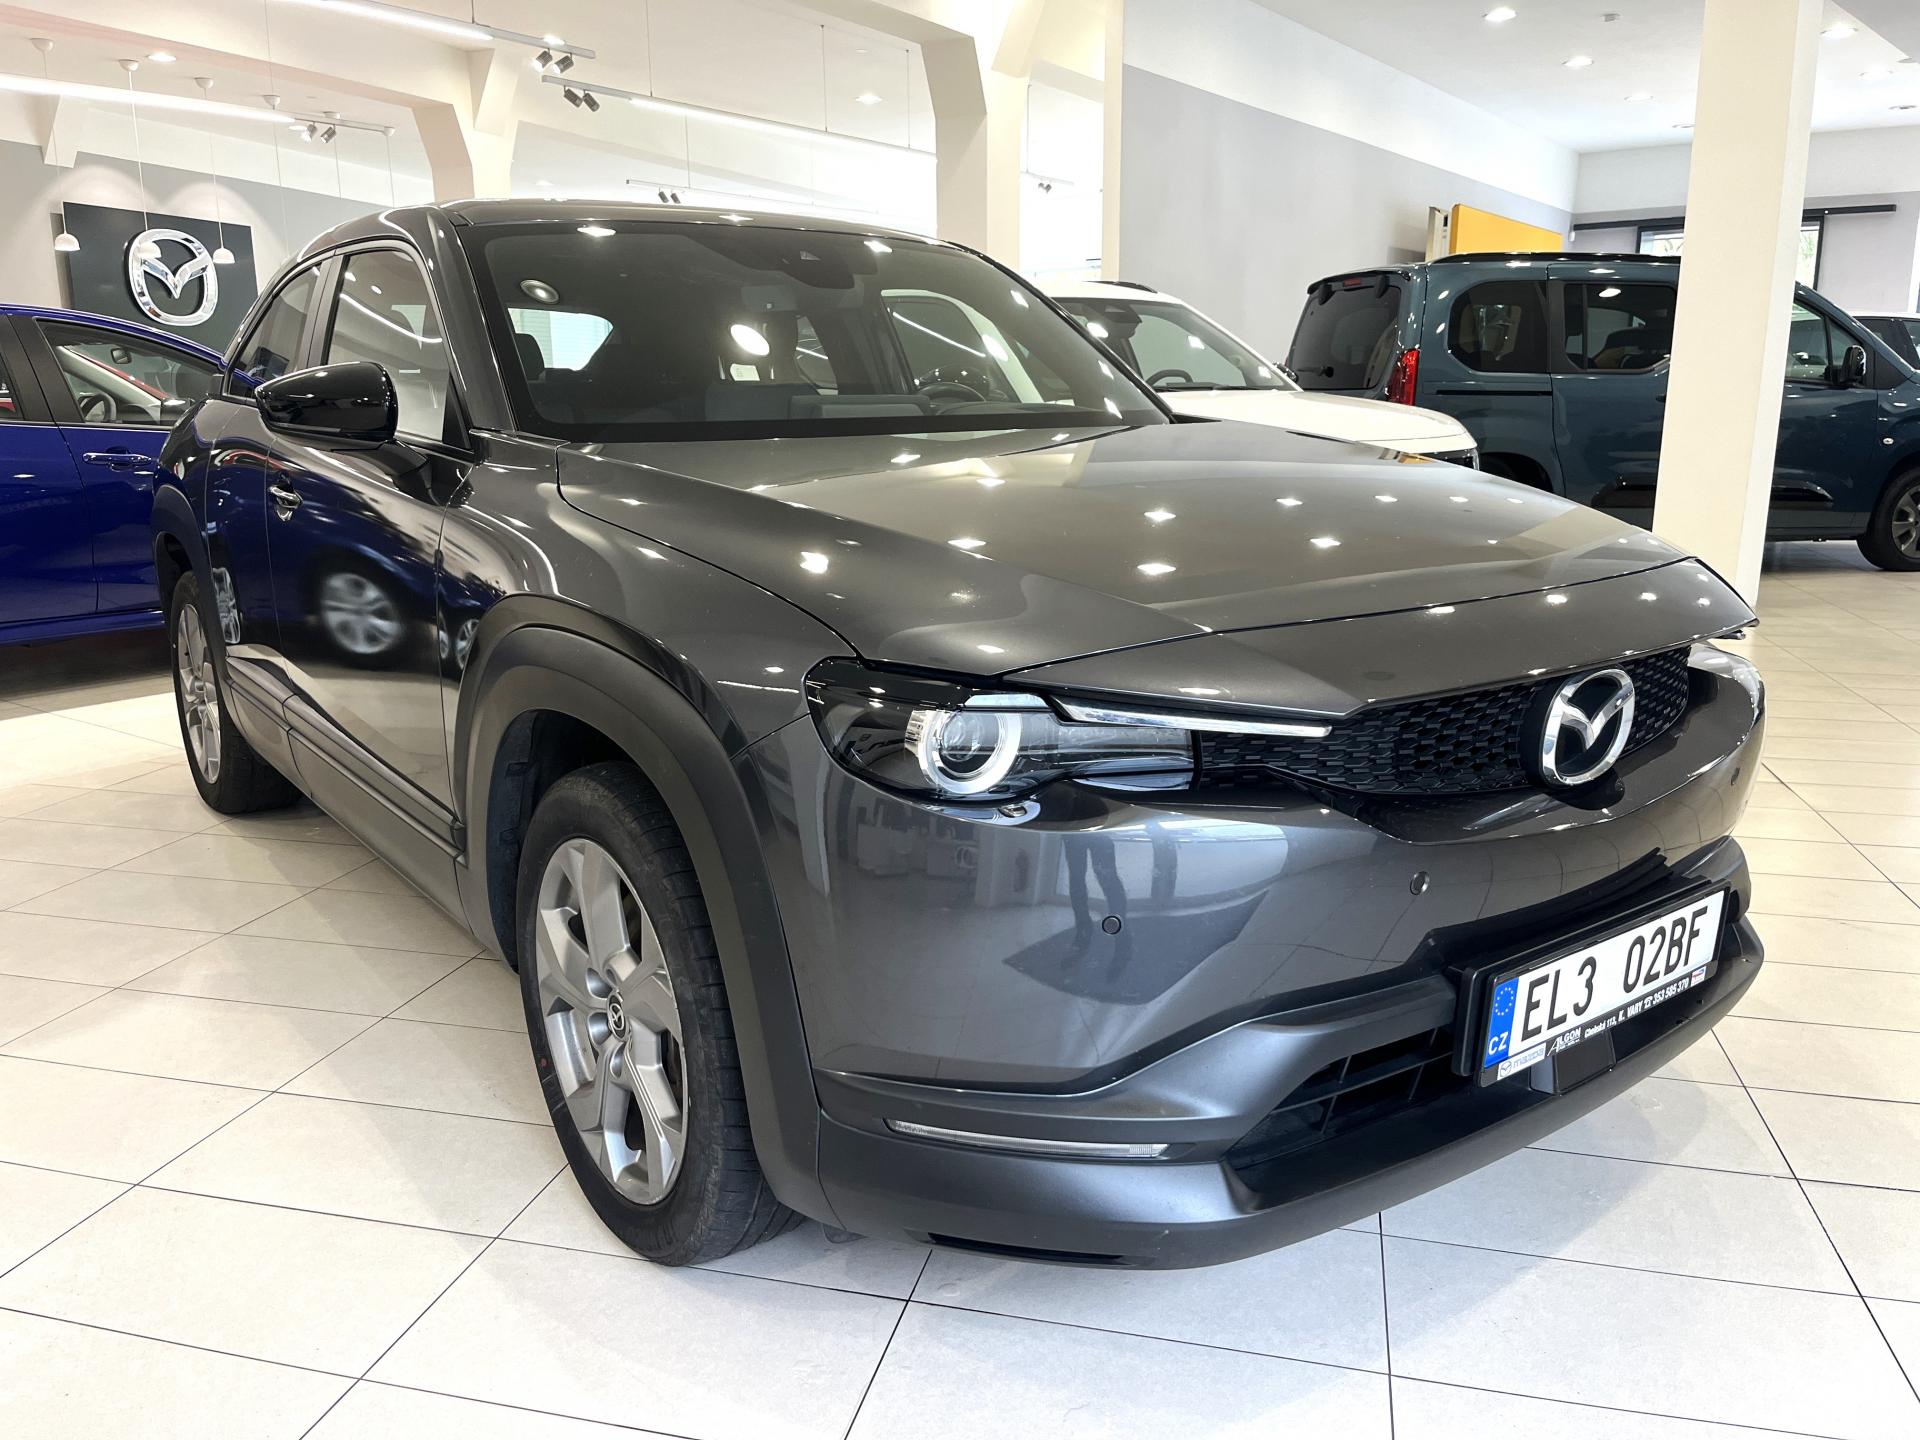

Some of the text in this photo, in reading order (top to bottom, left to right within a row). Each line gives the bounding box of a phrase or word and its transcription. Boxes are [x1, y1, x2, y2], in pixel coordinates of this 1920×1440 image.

[1521, 905, 1708, 1042] EL3 02BF
[1618, 1010, 1626, 1021] K.
[1627, 1001, 1643, 1018] VARY
[1653, 992, 1665, 1005] 353
[1677, 978, 1690, 992] 370
[1488, 1031, 1509, 1055] CZ
[1547, 1027, 1581, 1056] ALGON
